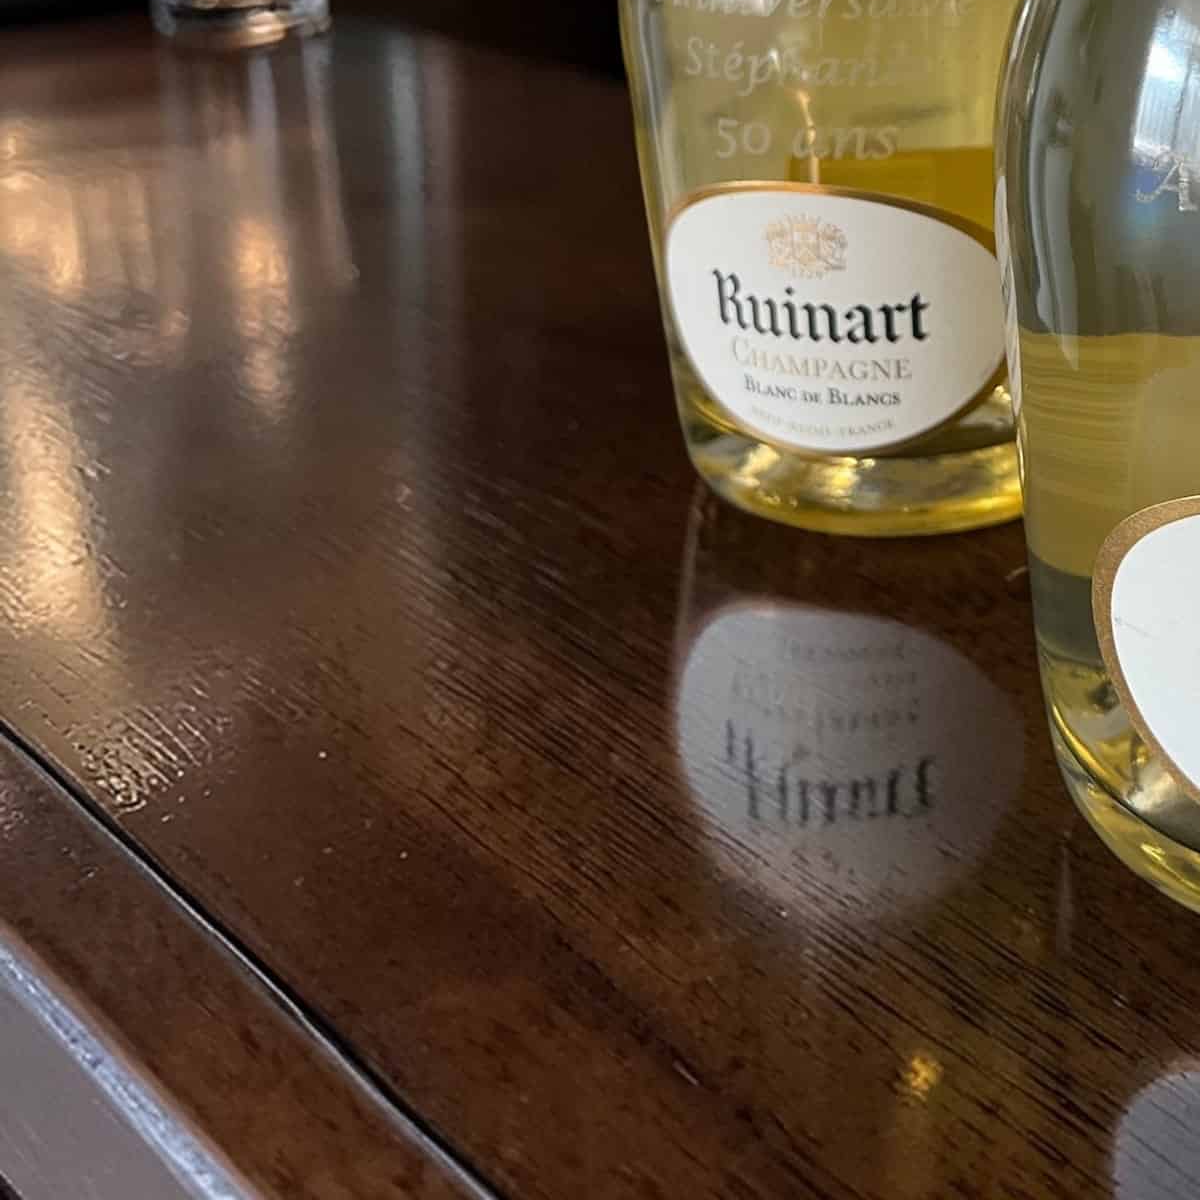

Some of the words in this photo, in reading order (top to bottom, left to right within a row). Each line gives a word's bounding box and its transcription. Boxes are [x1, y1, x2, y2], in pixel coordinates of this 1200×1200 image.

[716, 116, 772, 161] 50
[790, 124, 898, 161] ans
[711, 267, 931, 345] Ruinart
[733, 336, 913, 382] CHAMPAGNE
[743, 373, 797, 401] BLANC
[827, 386, 903, 407] BLANCS
